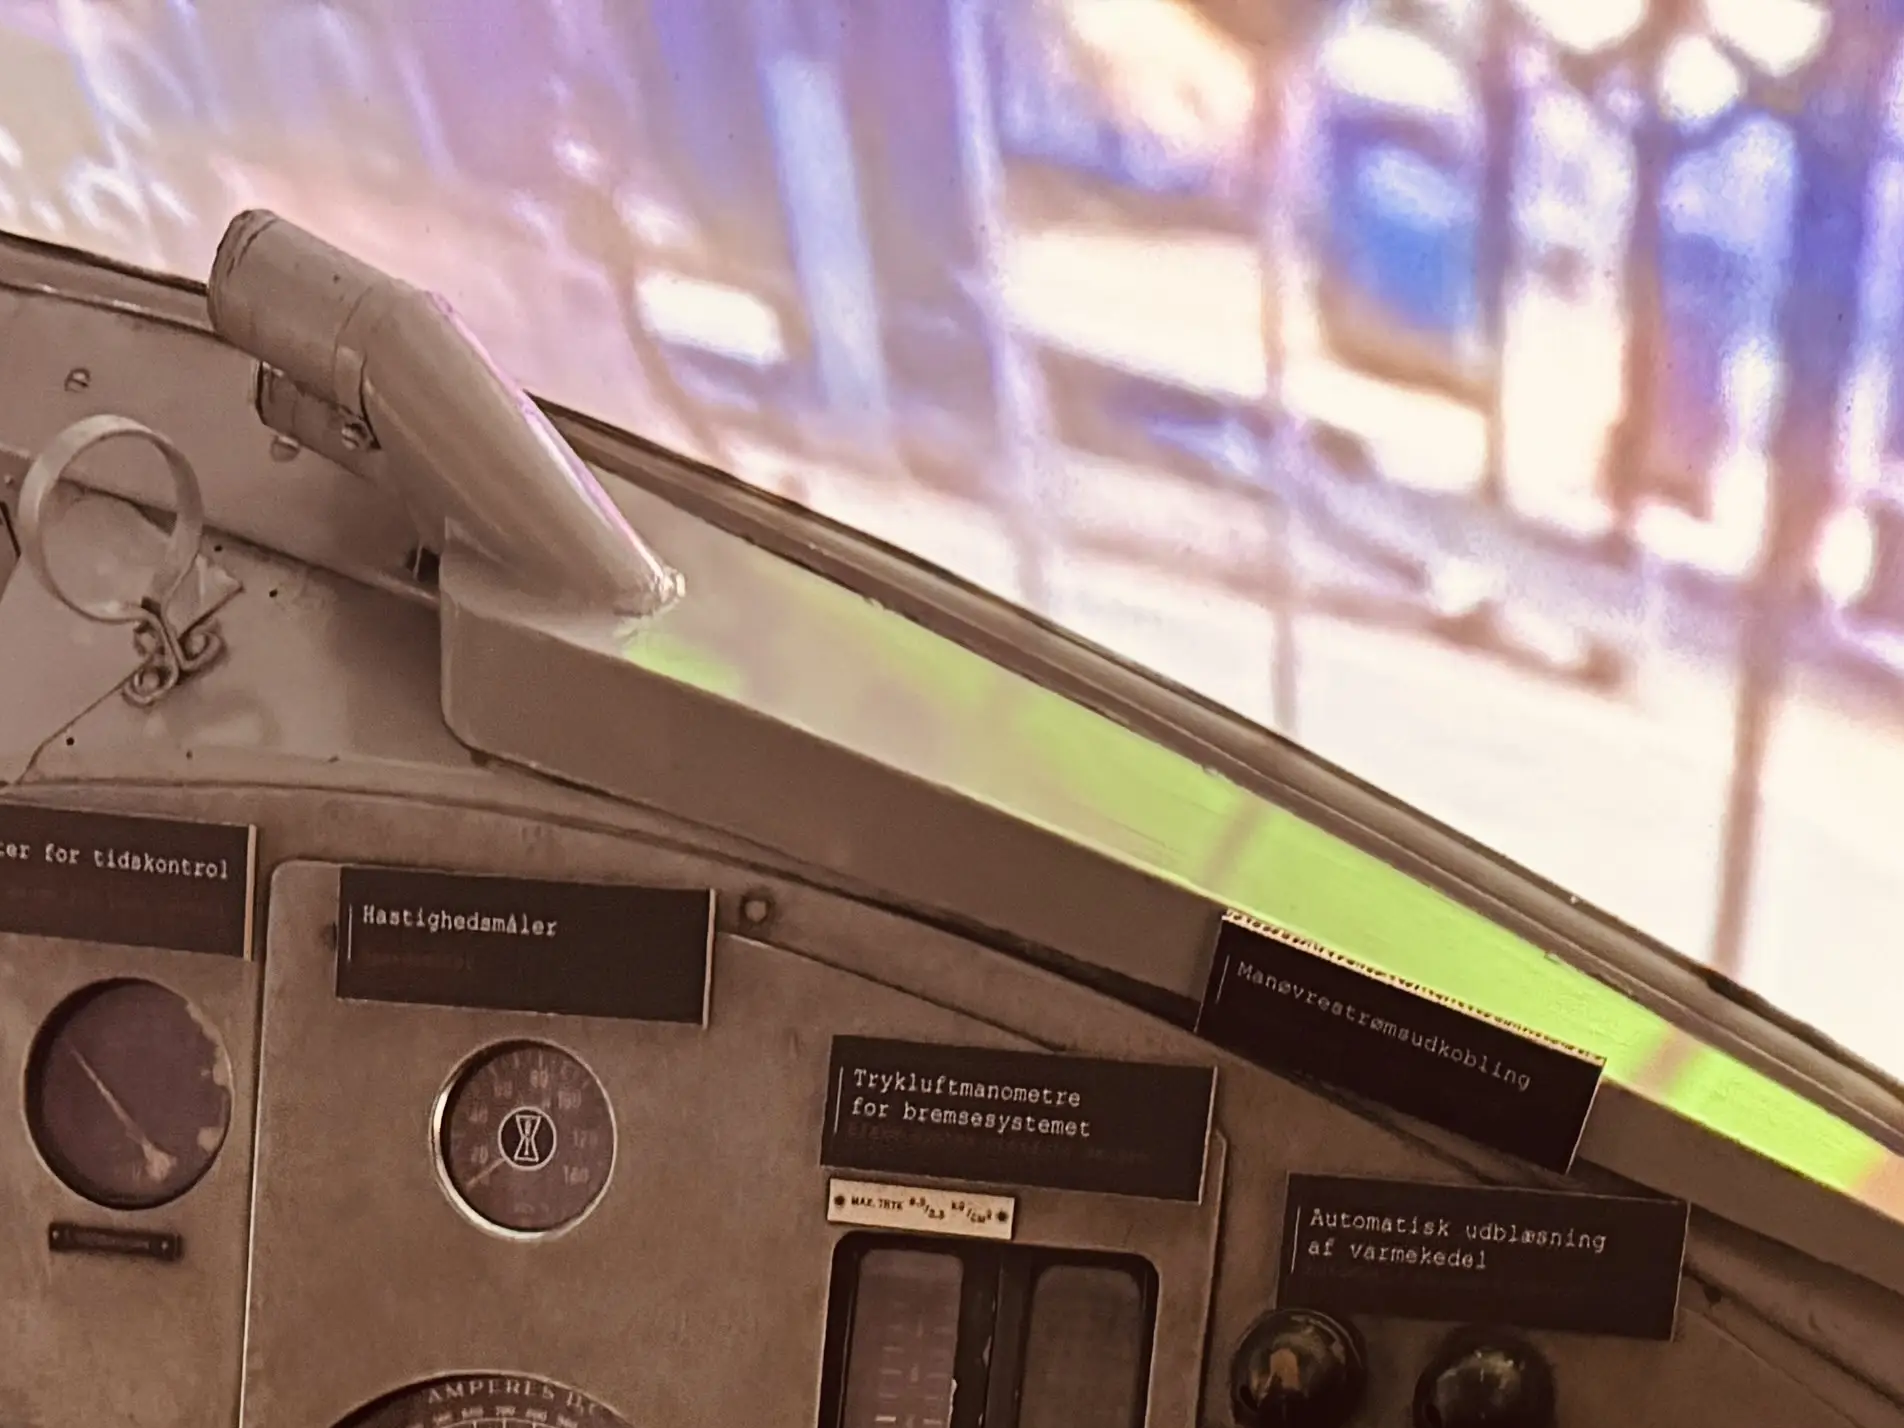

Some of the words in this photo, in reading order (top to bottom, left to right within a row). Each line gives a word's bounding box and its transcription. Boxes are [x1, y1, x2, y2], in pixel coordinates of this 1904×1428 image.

[45, 841, 81, 865] for
[94, 848, 229, 880] tidskontrol
[362, 904, 559, 937] Hastighedsmåler
[1235, 958, 1533, 1091] Manøvrestrømsudkobling
[853, 1067, 1082, 1108] Trykluftmanometre
[850, 1097, 890, 1119] for
[902, 1101, 1092, 1139] bremsesystemet
[1309, 1206, 1451, 1238] Automatisk
[1465, 1221, 1608, 1255] udblæsning
[1307, 1237, 1335, 1259] af
[1349, 1241, 1487, 1269] varmekedel
[427, 1379, 556, 1405] AMPERES
